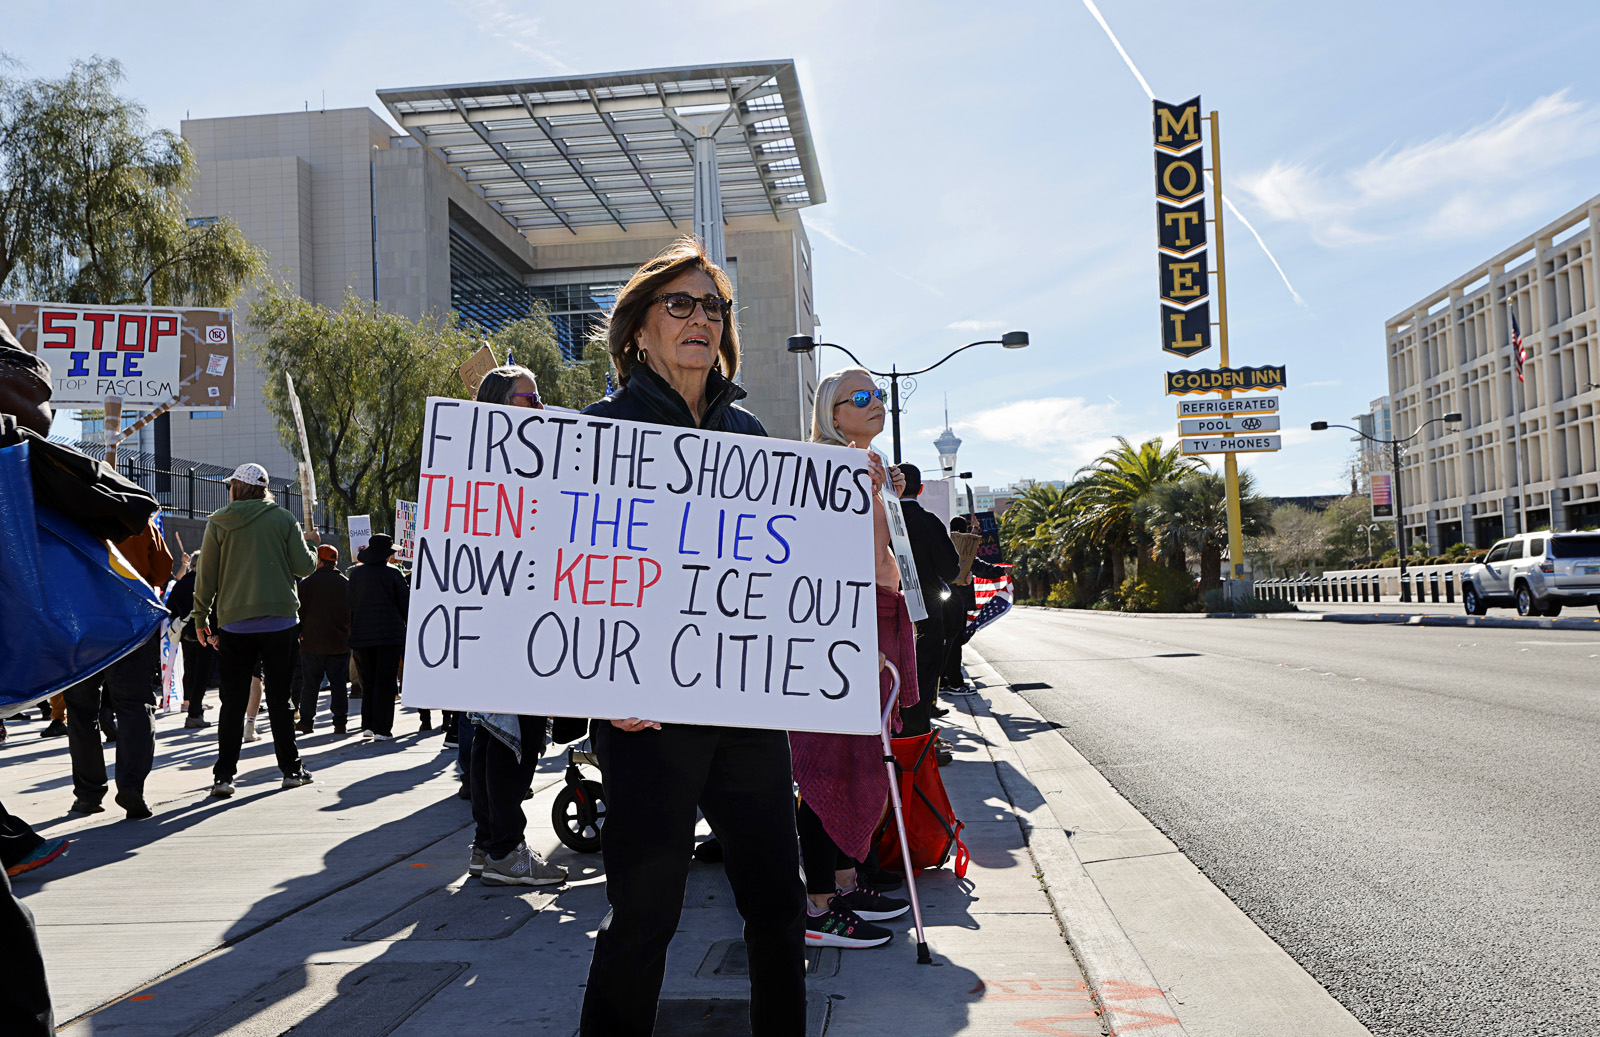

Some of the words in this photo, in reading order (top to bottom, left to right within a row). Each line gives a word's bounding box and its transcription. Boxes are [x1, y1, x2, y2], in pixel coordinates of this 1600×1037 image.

[1156, 105, 1203, 349] MOTEL
[42, 311, 178, 352] STOP
[67, 351, 145, 377] ICE
[52, 378, 87, 392] TOP
[96, 379, 174, 398] FASCISM
[1171, 371, 1245, 388] GOLDEN
[1251, 369, 1281, 384] INN
[1183, 399, 1276, 413] REFRIGERATED
[1199, 421, 1231, 431] POOL
[1243, 418, 1261, 430] AAA
[1194, 441, 1209, 451] TV
[1220, 438, 1270, 449] PHONES
[587, 422, 662, 490] THE
[667, 433, 871, 515] SHOOTINGS
[421, 474, 538, 539] THEN:
[560, 491, 655, 551] THE
[679, 501, 797, 564] LIES
[349, 528, 370, 537] SHAME
[403, 530, 416, 540] THE
[416, 538, 536, 596] NOW:
[554, 548, 662, 608] KEEP
[680, 565, 772, 620] ICE
[789, 575, 871, 629] OUT
[418, 604, 484, 669] OF
[527, 612, 640, 685] OUR
[670, 624, 862, 701] CITIES
